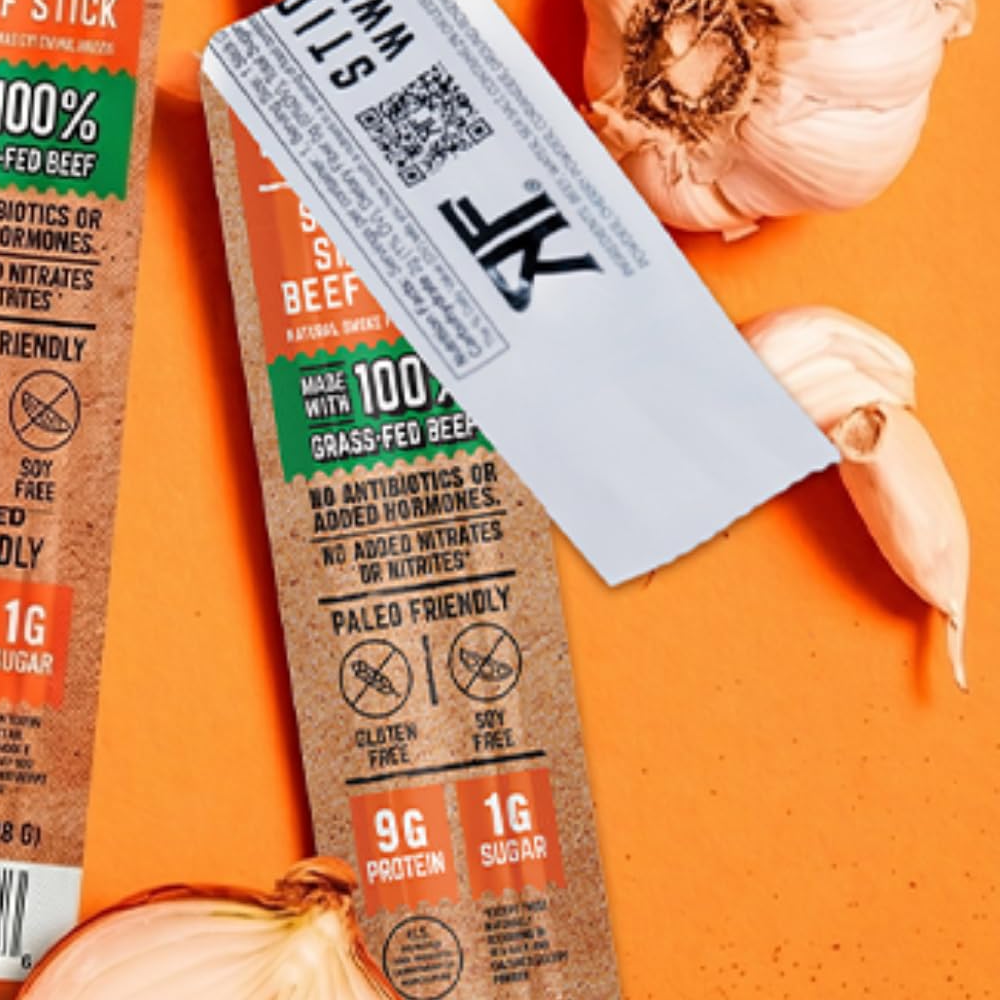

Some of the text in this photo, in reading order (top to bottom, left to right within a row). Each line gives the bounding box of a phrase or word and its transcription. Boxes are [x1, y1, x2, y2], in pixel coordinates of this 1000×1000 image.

[45, 150, 97, 177] BEEF
[76, 207, 103, 230] OR
[9, 263, 94, 290] NITRATES
[281, 273, 360, 316] BEEF
[301, 354, 454, 416] MADE 100
[305, 394, 351, 419] WITH
[311, 420, 422, 460] GRASS-FED
[20, 457, 53, 478] SOY
[14, 478, 54, 500] FREE
[308, 462, 498, 509] NO ANTIBIOTICS OR
[313, 504, 380, 533] ADDED
[321, 520, 504, 566] NO ADDED NITRATES
[4, 599, 46, 646] 1G
[331, 586, 510, 636] PALEO FRIENDLY
[474, 709, 505, 729] SOY
[355, 723, 417, 748] GLUTEN
[472, 728, 515, 751] FREE
[369, 744, 410, 768] FREE
[483, 791, 532, 836] 1G
[373, 808, 428, 853] 9G
[480, 835, 548, 867] SUGAR
[366, 851, 446, 884] PROTEIN
